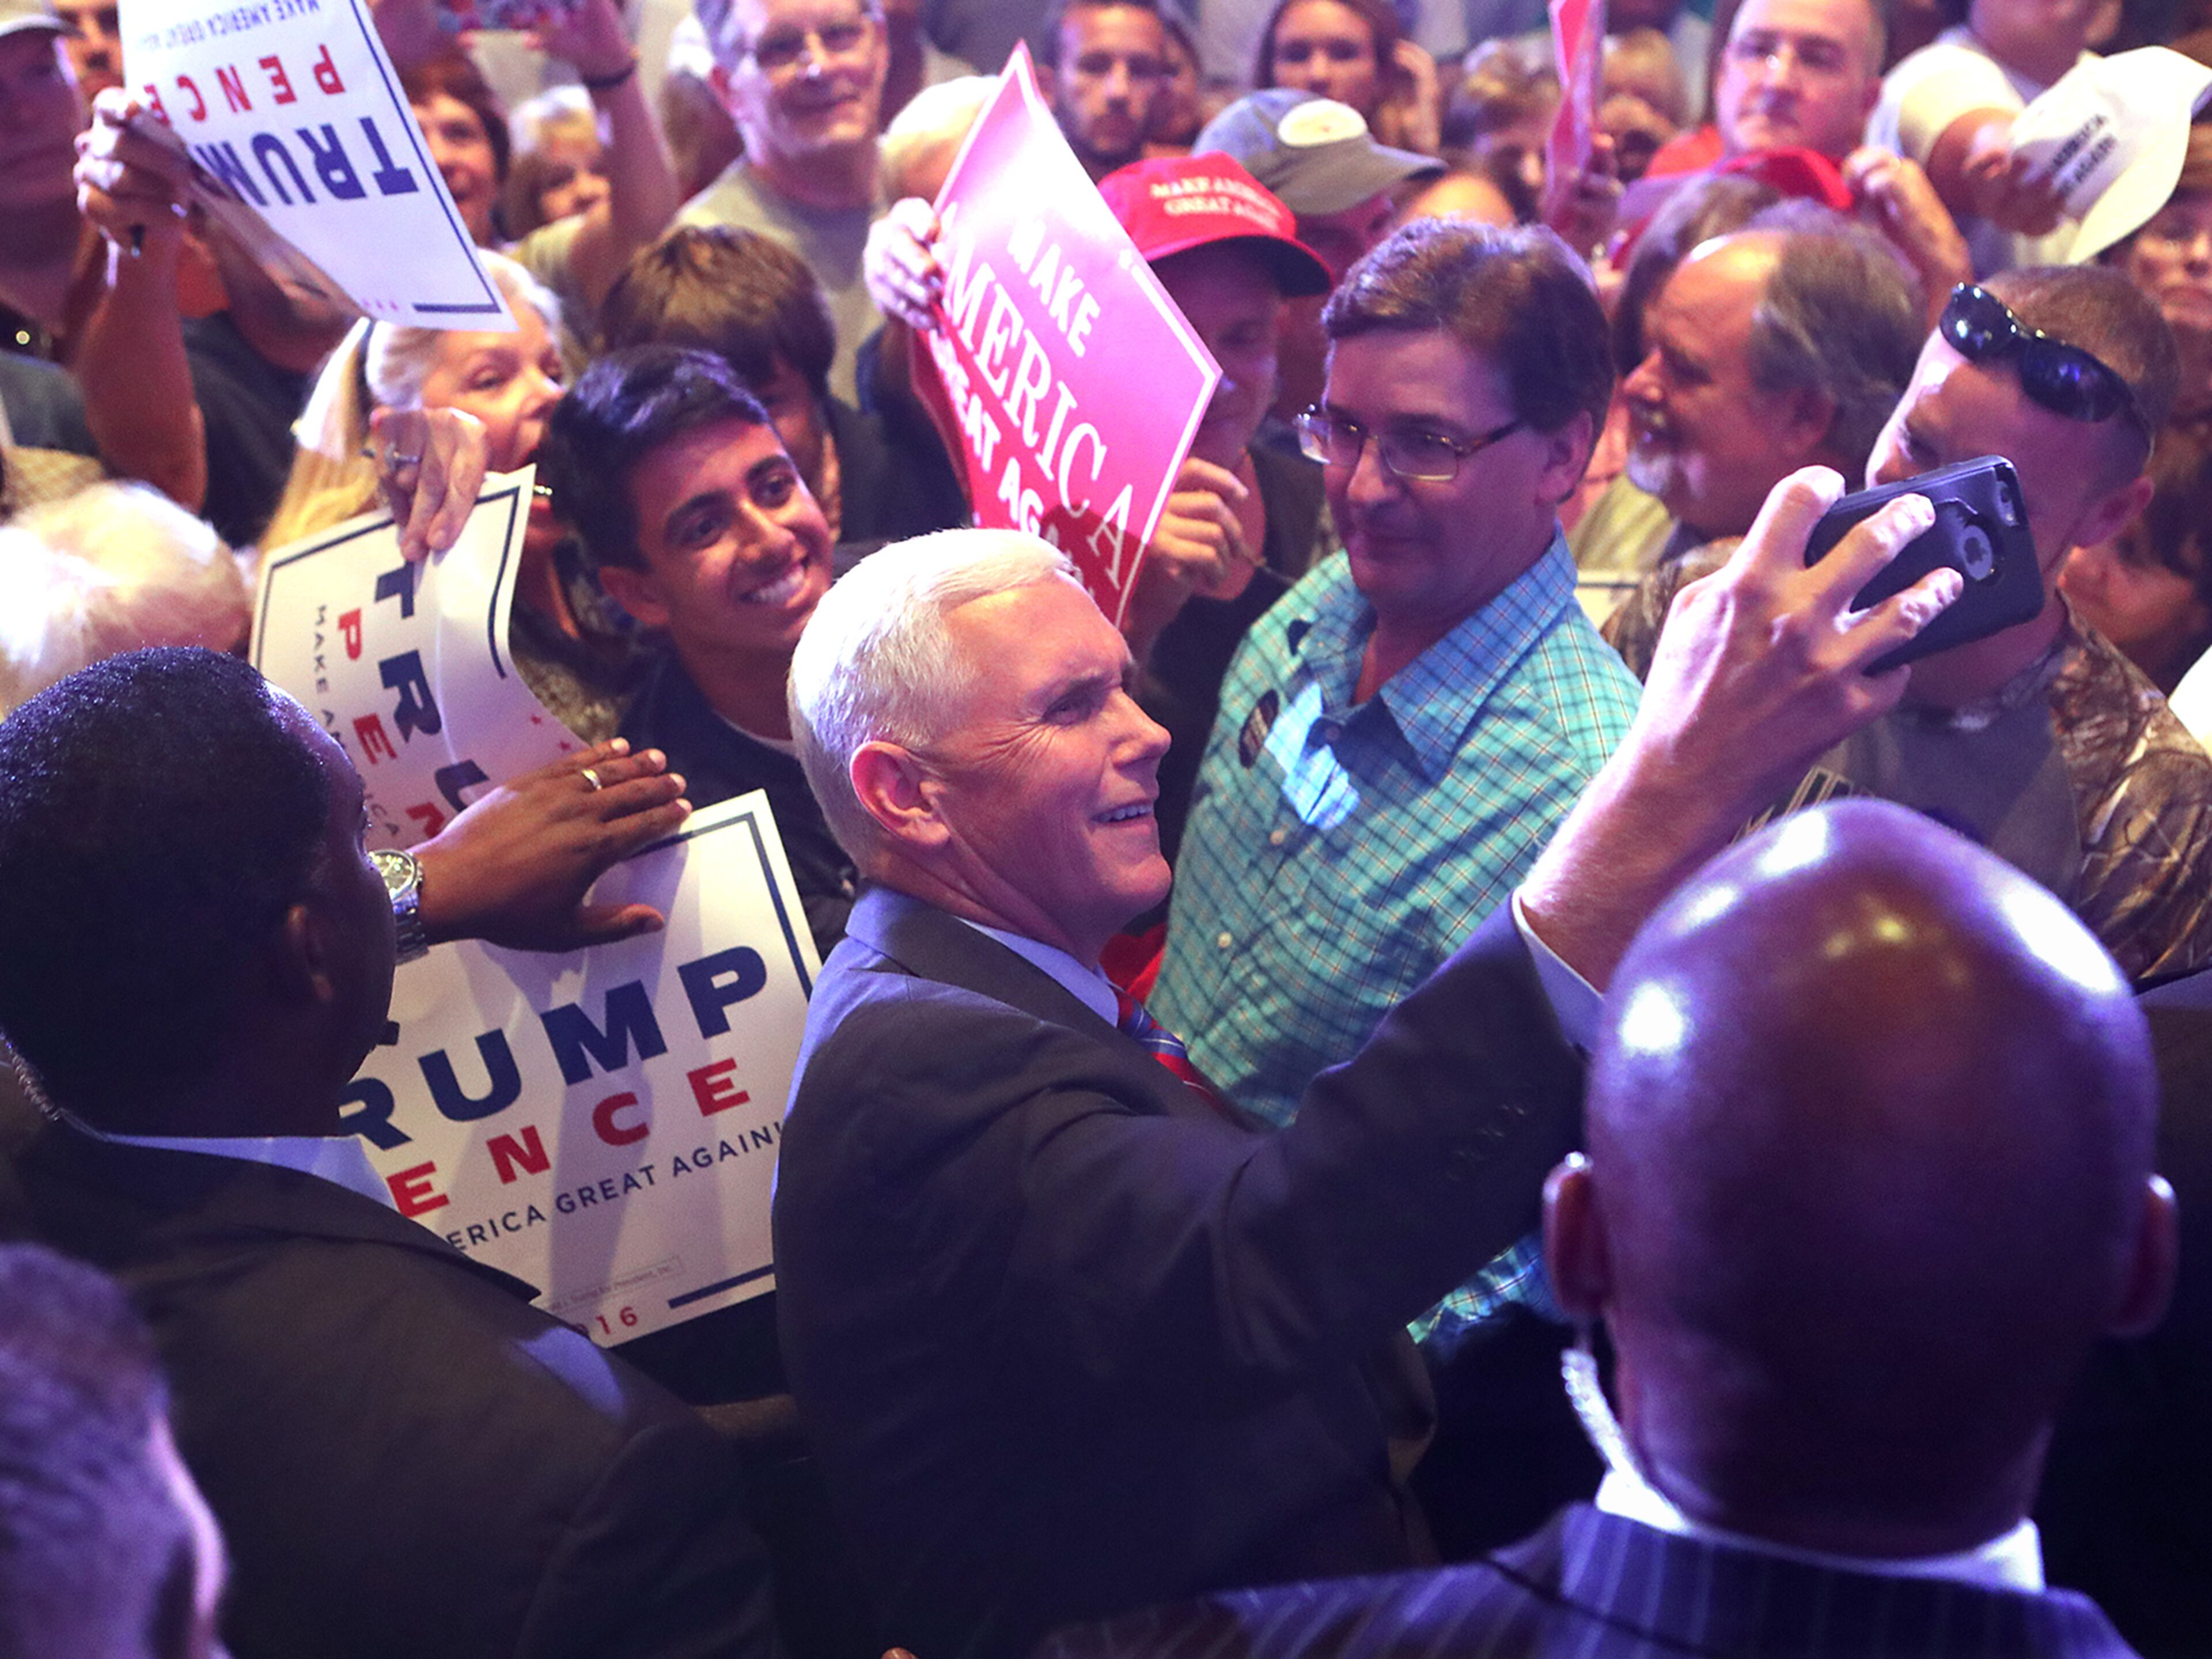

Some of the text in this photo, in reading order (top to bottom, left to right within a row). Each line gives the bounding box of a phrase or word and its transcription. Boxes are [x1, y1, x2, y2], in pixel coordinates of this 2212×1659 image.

[143, 43, 347, 127] PENCE
[189, 116, 419, 207] TRUM
[1006, 215, 1101, 358] MAKE
[314, 604, 329, 692] MAKE
[338, 945, 768, 1152] RUMP
[385, 1057, 751, 1219] ENCE
[446, 1204, 546, 1251] ERICA
[555, 1164, 656, 1214] GREAT
